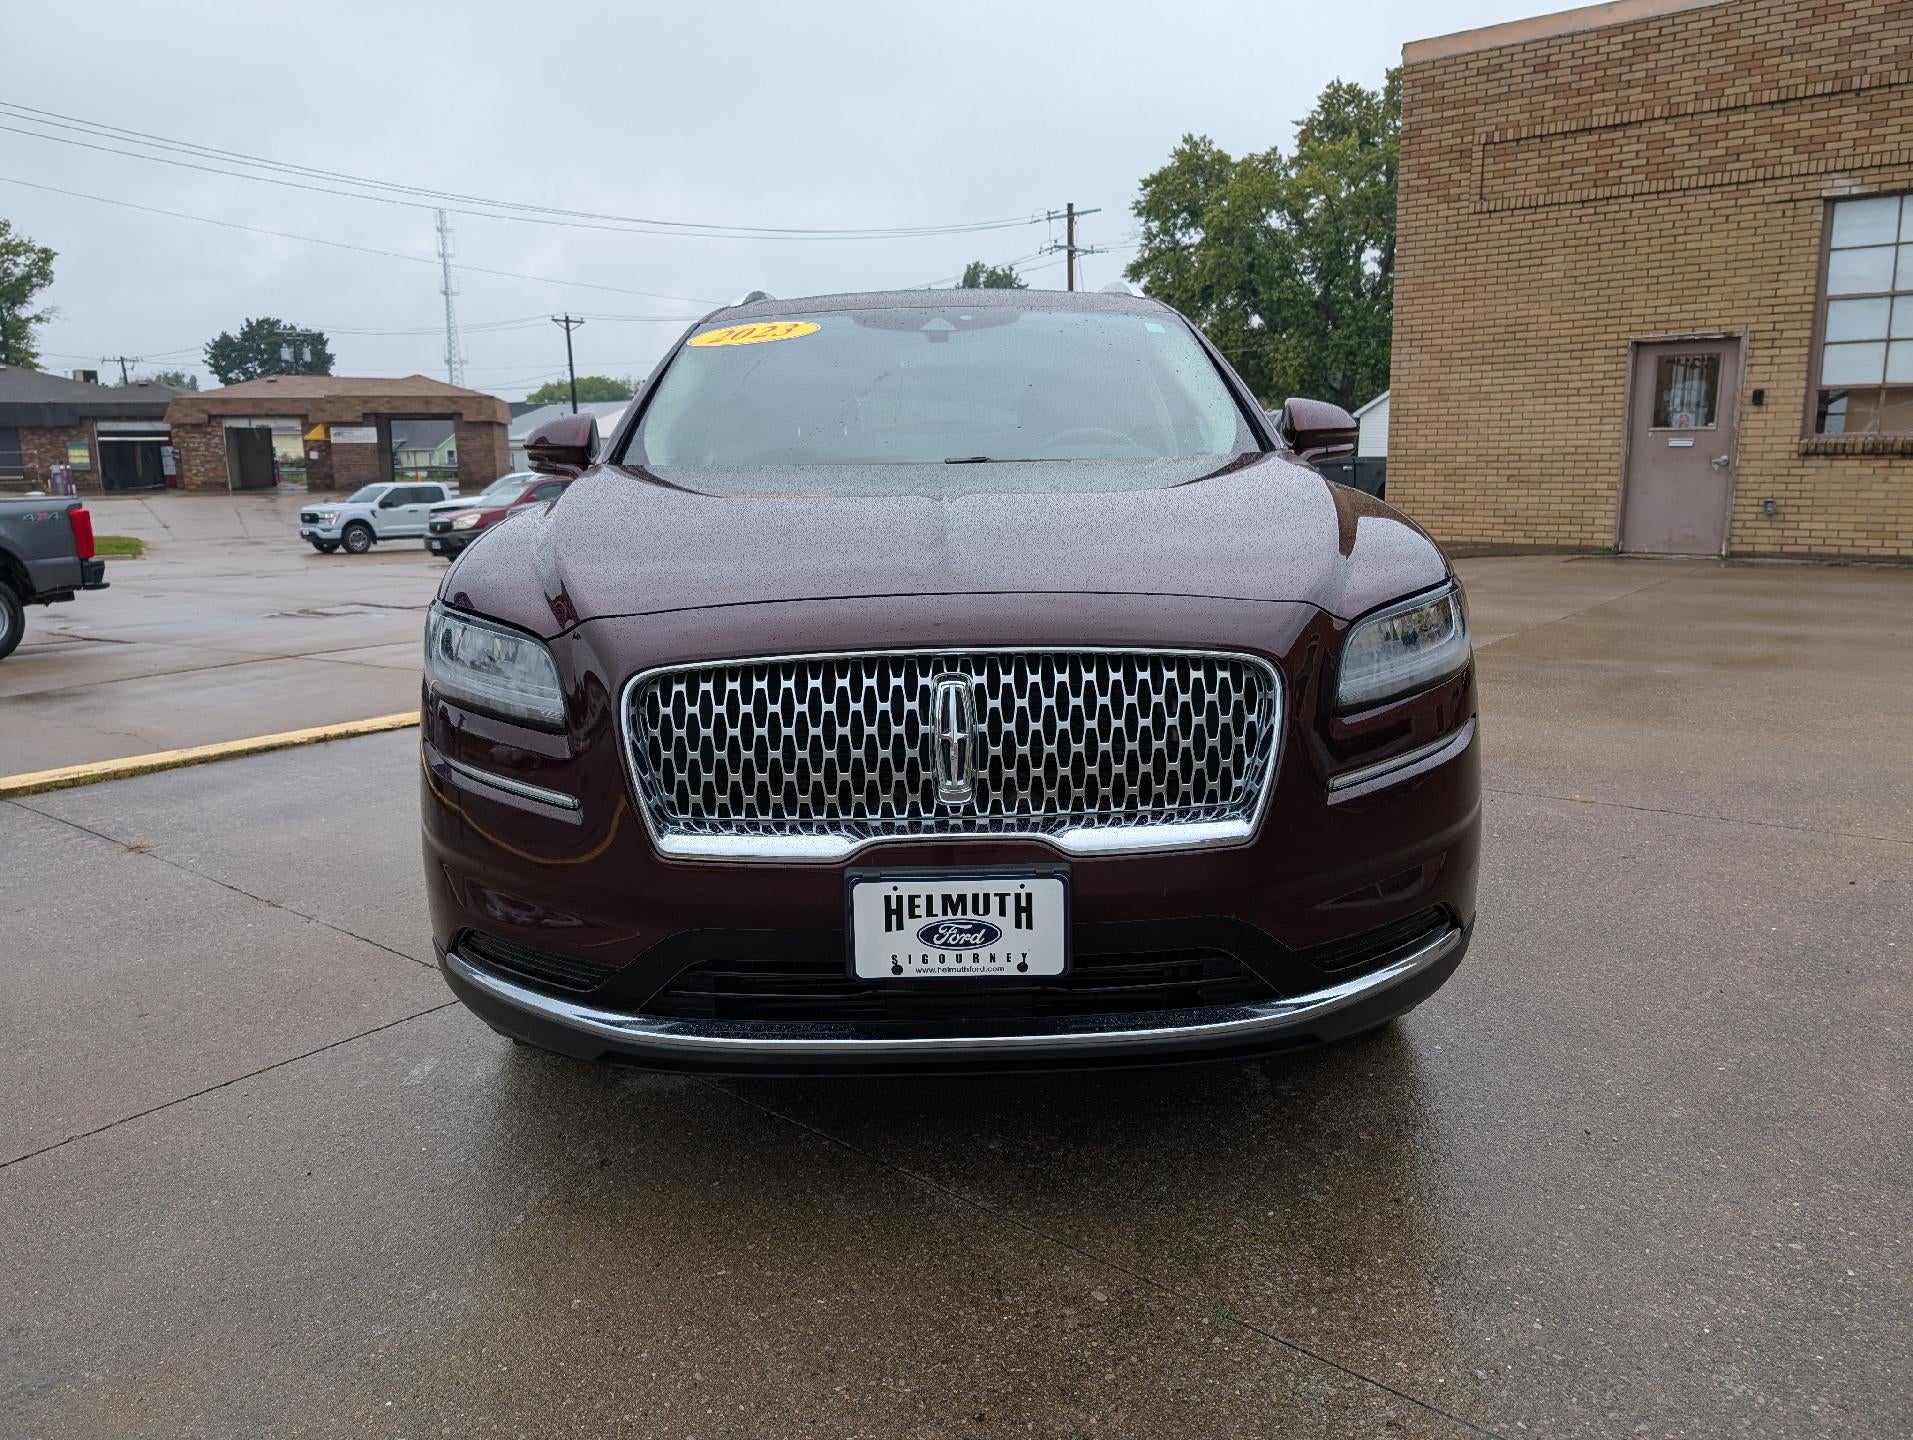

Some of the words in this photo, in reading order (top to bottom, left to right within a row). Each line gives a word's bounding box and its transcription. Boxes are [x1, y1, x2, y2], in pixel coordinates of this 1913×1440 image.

[707, 323, 800, 344] 2023
[883, 892, 1034, 932] HELMUTH
[932, 923, 987, 945] Ford
[891, 952, 1028, 966] SIGOURNEY
[915, 965, 1006, 974] www.helmuthford.com
